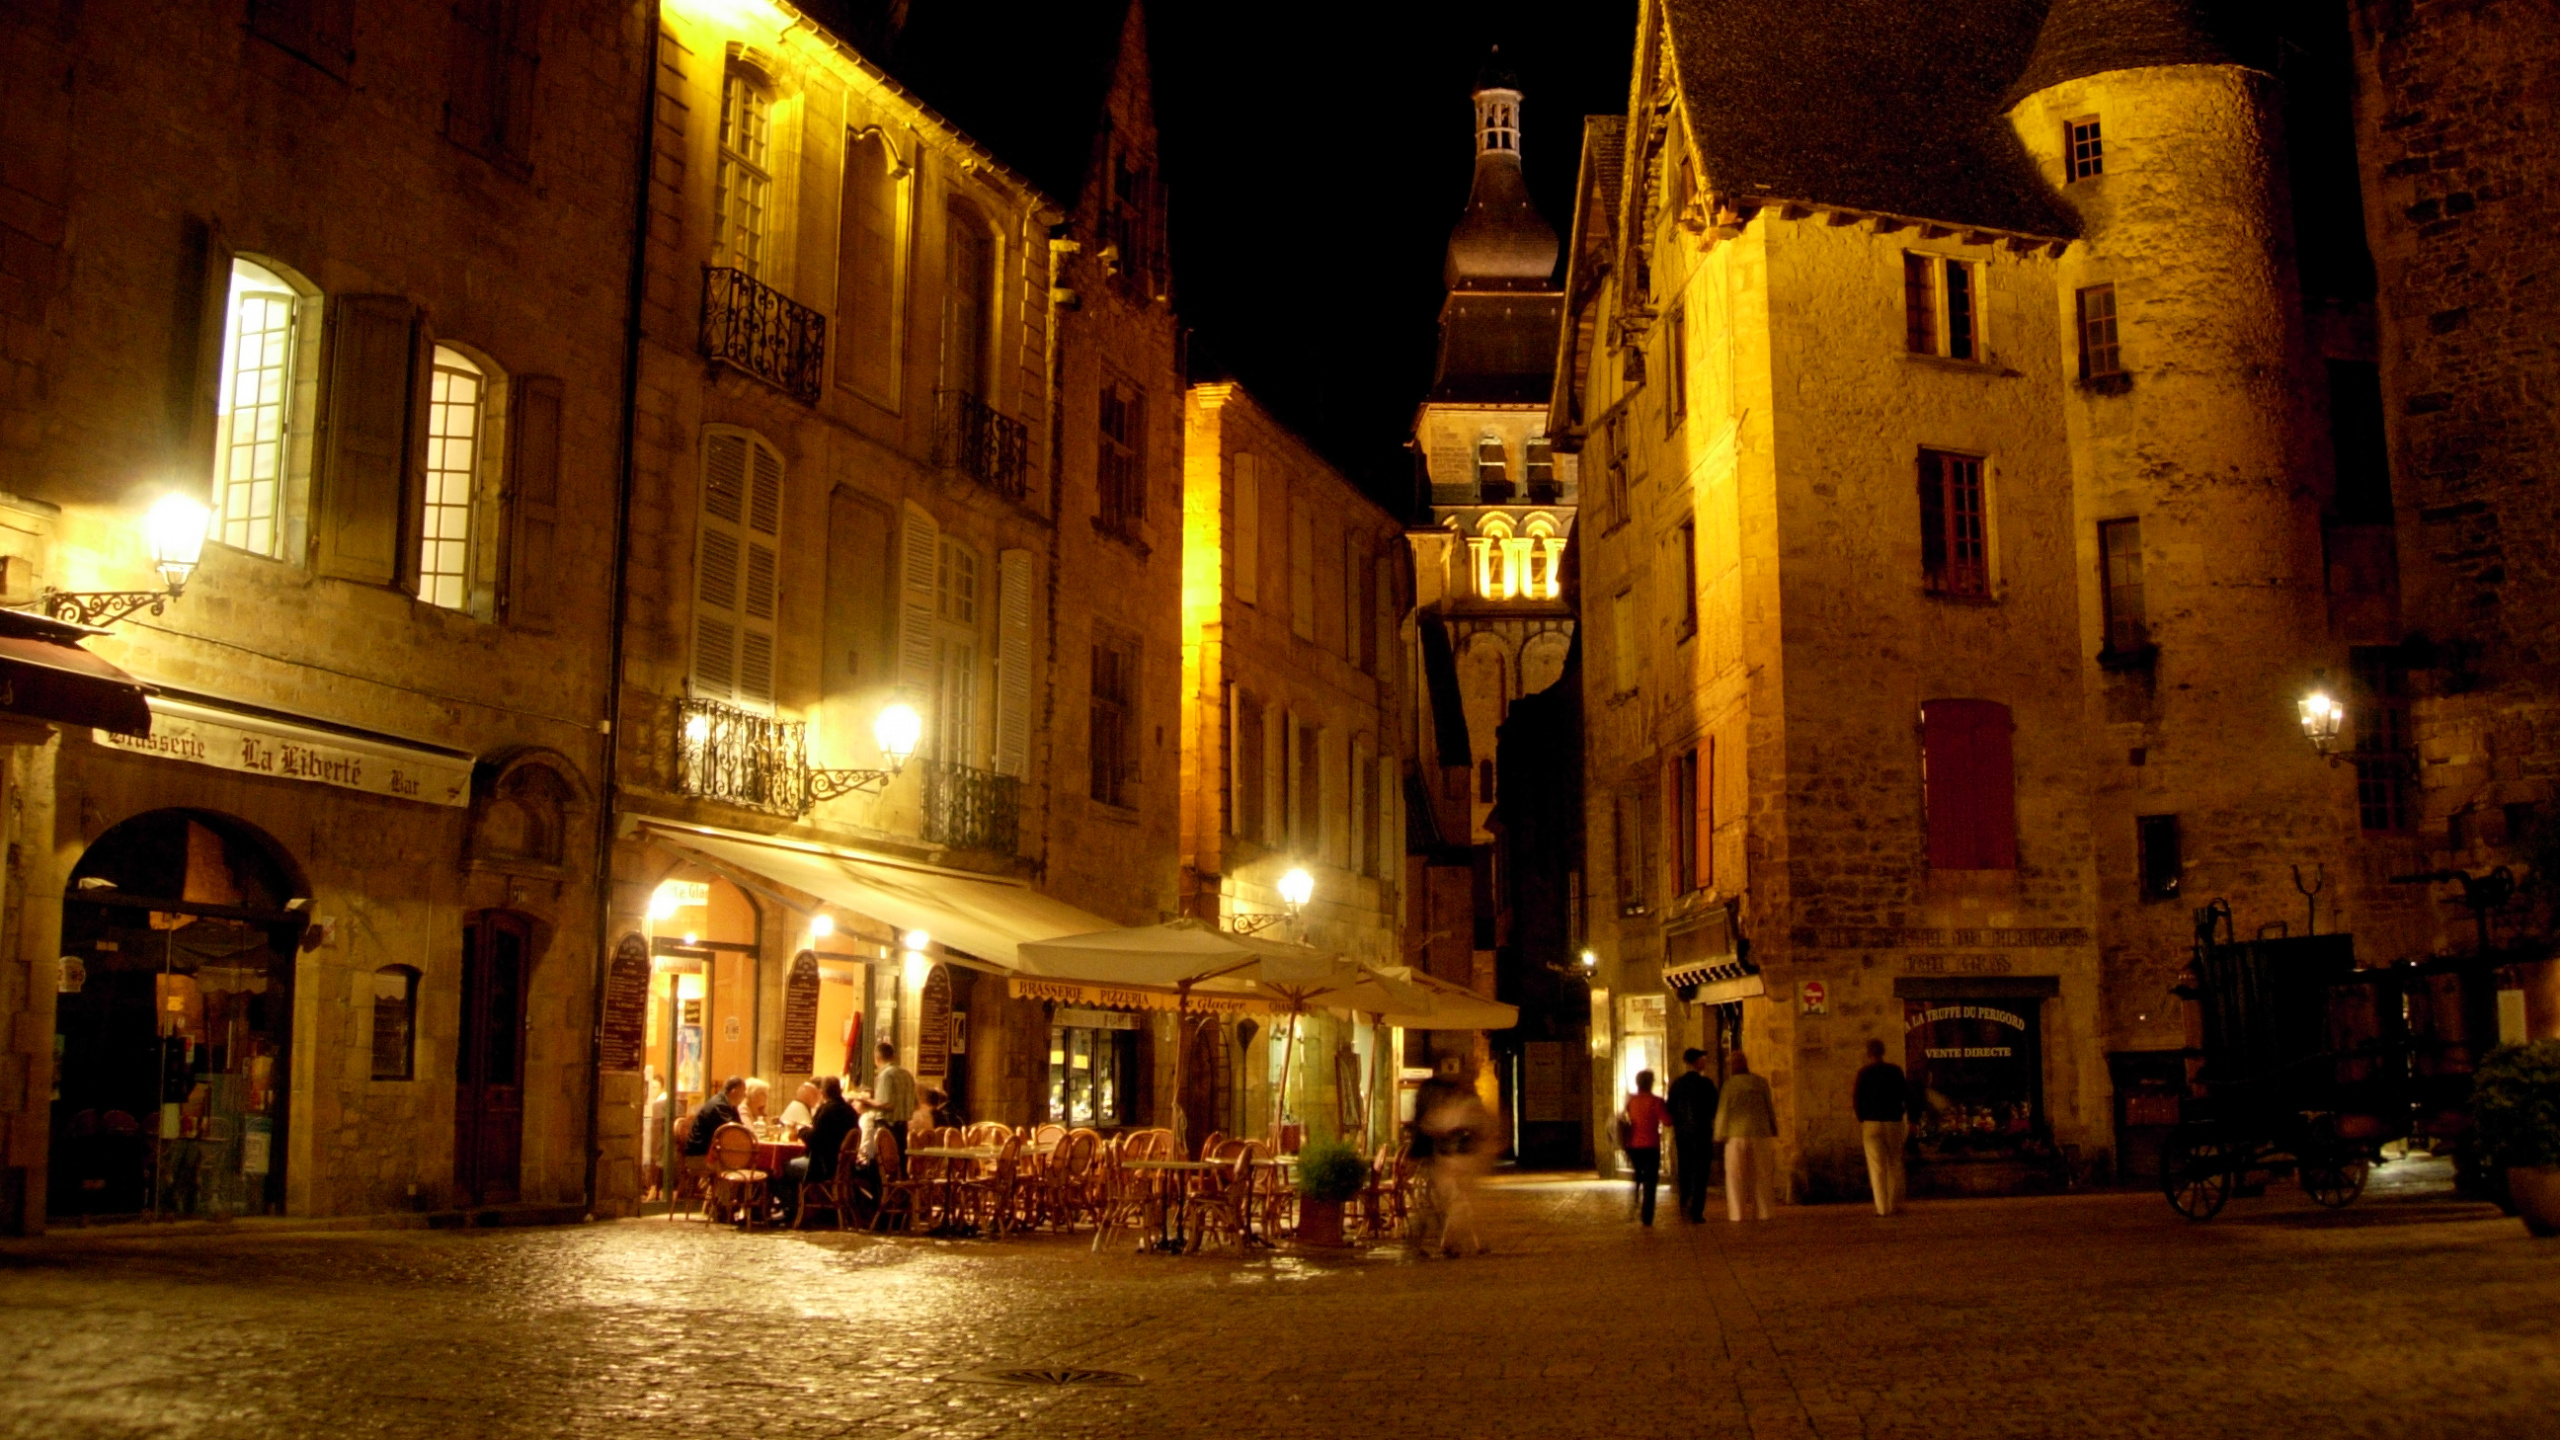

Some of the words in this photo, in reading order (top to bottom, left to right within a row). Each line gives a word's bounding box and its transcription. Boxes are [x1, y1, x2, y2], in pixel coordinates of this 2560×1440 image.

[242, 737, 274, 773] La
[281, 744, 362, 786] Liberté
[390, 768, 420, 796] Bar
[1018, 981, 1084, 1000] BRASSERIE
[1100, 988, 1149, 1005] PIZZERIA
[1198, 997, 1246, 1011] Glacier
[1912, 1012, 1925, 1028] LA
[1926, 1006, 1961, 1022] TRUFFE
[1963, 1006, 1977, 1019] DU
[1979, 1006, 2025, 1032] PERIGORD
[1926, 1048, 1961, 1059] VENTE
[1964, 1047, 2012, 1058] DIRECTE
